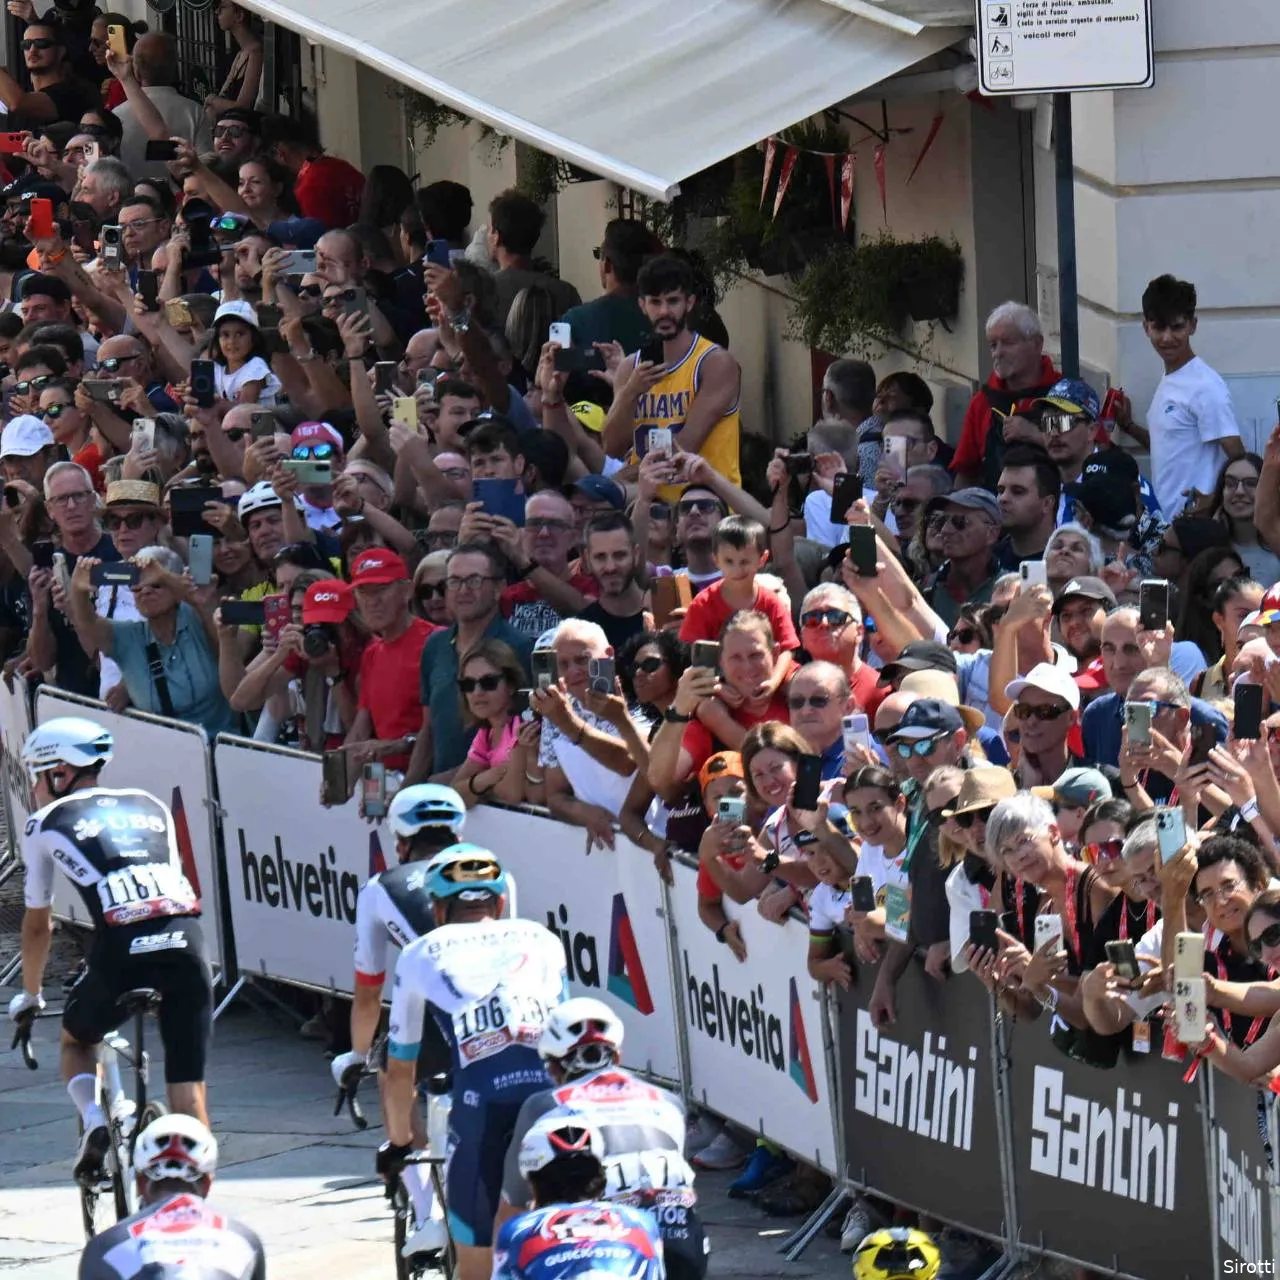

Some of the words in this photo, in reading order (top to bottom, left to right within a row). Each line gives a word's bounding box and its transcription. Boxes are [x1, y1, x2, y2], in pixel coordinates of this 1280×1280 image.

[1017, 10, 1034, 18] vigili
[1023, 32, 1051, 40] veicoli
[1053, 30, 1076, 39] merci
[1045, 18, 1068, 26] servizio
[634, 391, 690, 420] MIAMI
[238, 827, 358, 925] helvetia
[459, 994, 506, 1037] 106
[682, 949, 786, 1073] helvetia
[855, 1008, 978, 1152] Santini
[1030, 1064, 1180, 1212] Santini
